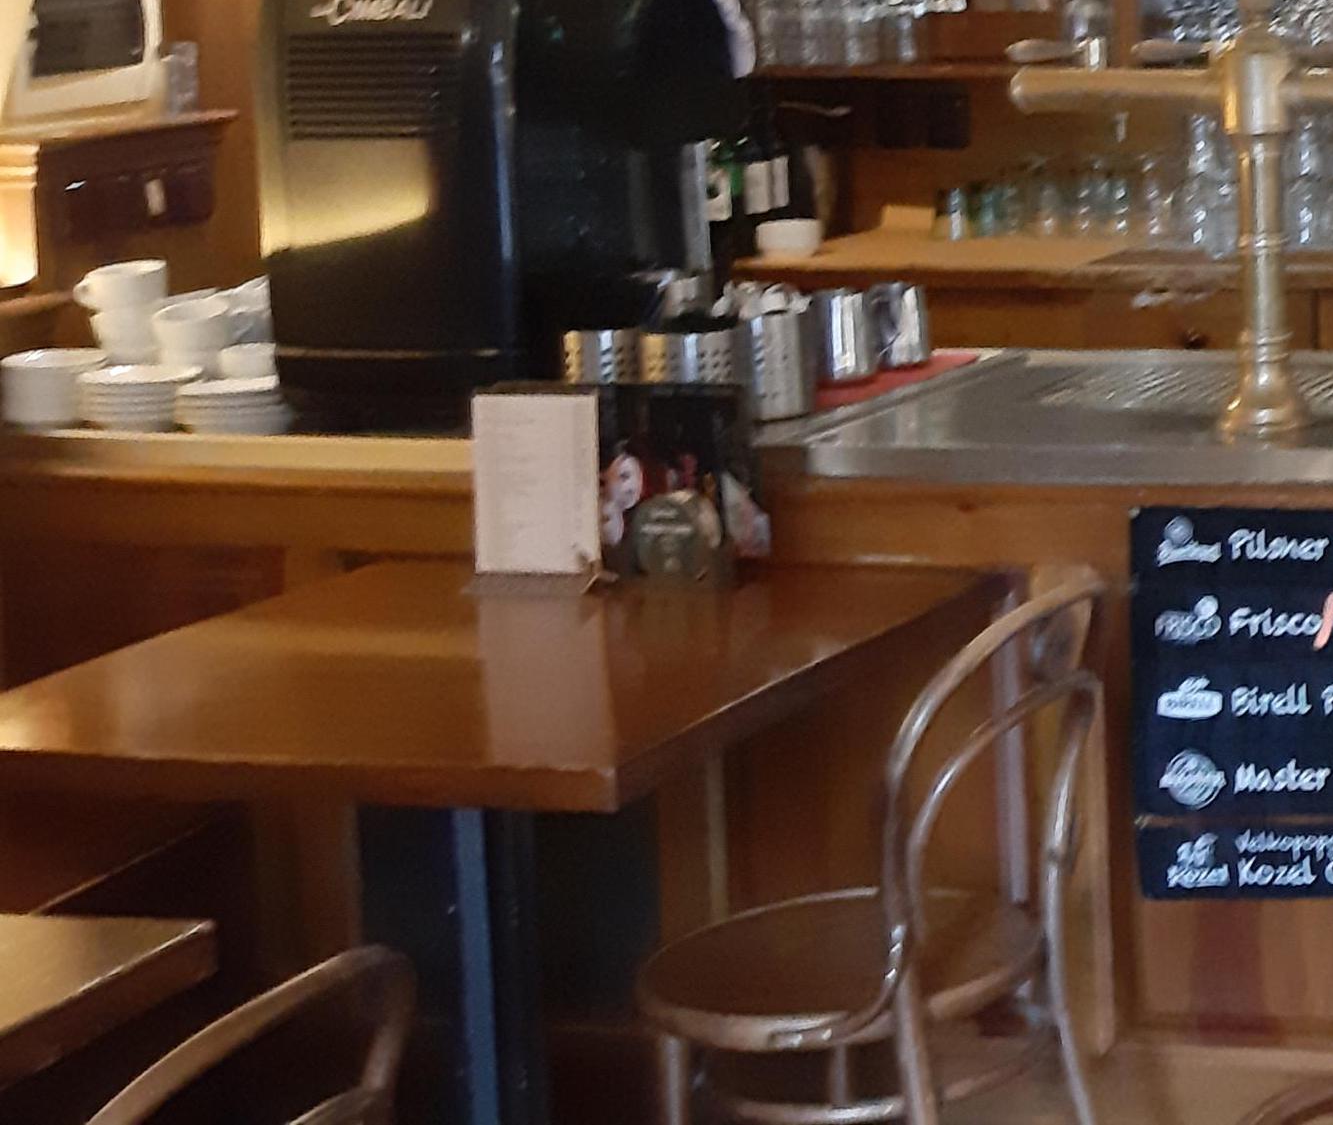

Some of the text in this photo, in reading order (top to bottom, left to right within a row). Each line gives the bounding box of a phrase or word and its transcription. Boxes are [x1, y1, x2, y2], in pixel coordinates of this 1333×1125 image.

[1228, 528, 1330, 561] Pilsner
[1230, 683, 1313, 717] Birell
[1233, 758, 1331, 794] Master
[1237, 856, 1318, 887] Kozel
